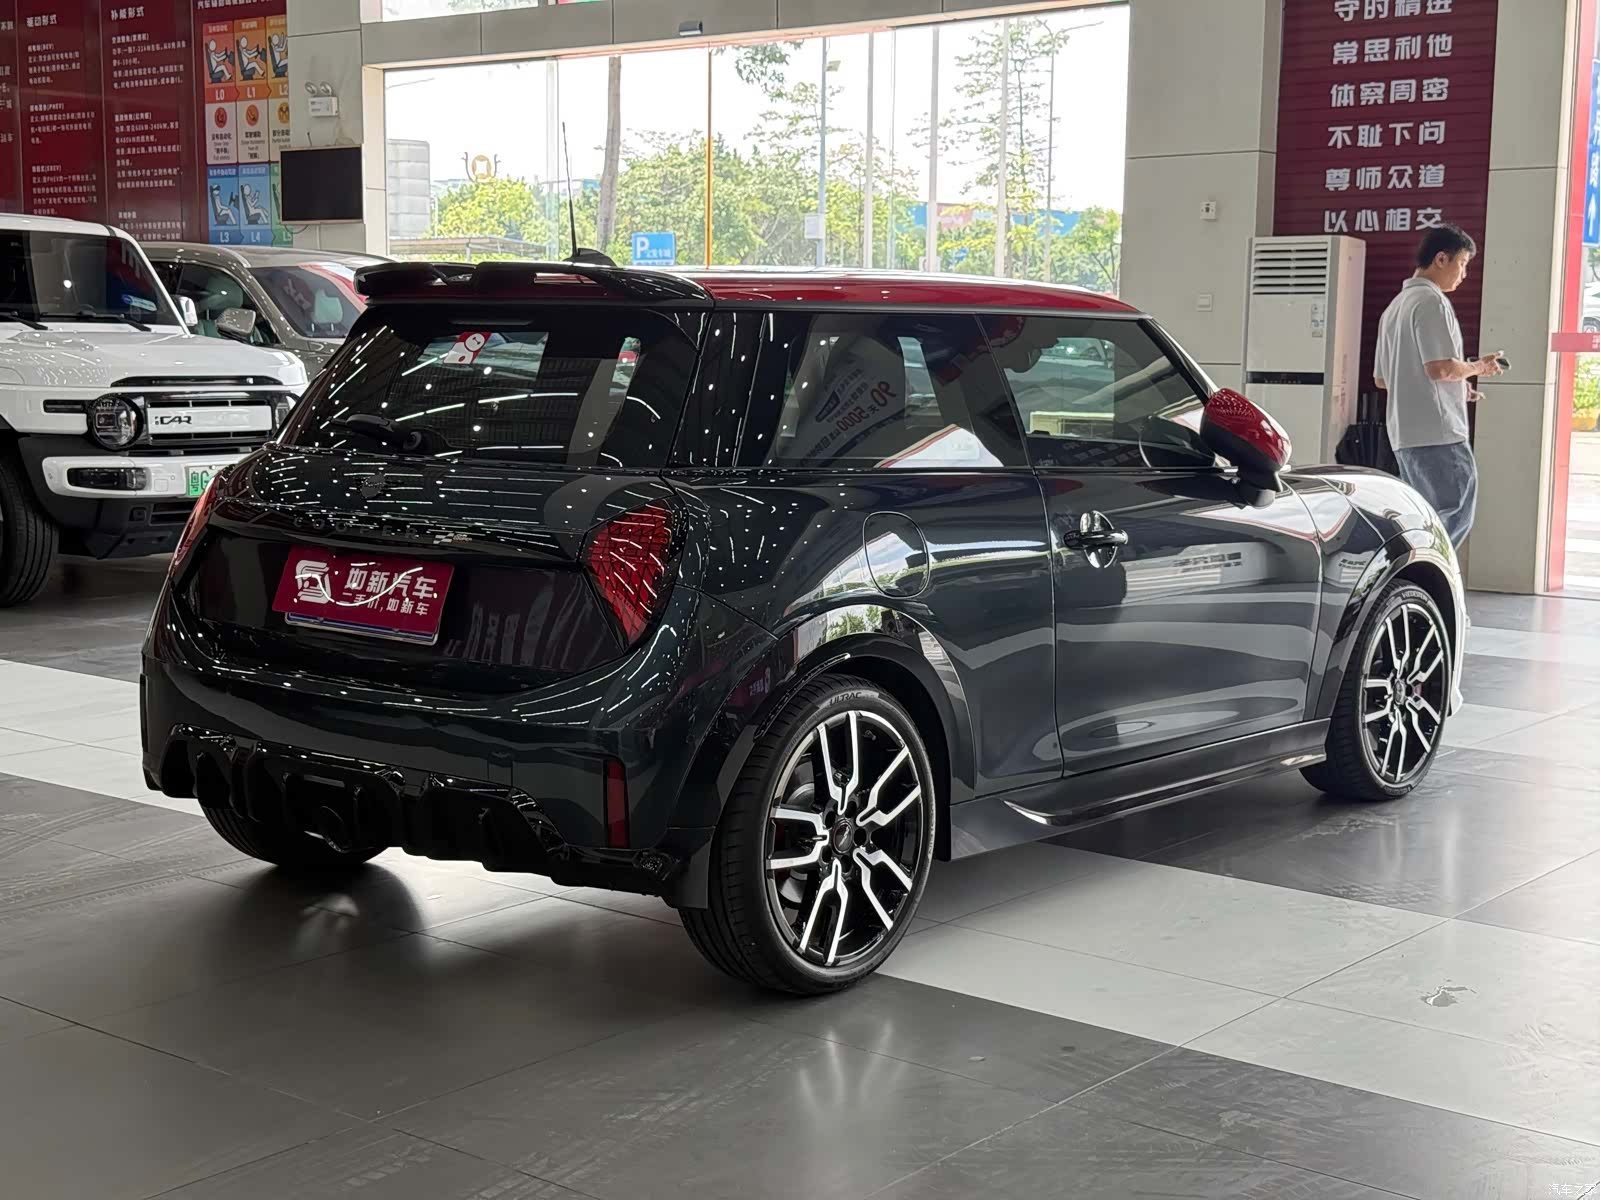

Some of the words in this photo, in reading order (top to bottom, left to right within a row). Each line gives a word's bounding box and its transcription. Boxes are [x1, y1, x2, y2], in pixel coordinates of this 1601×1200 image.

[26, 14, 57, 27] 驱动形式
[110, 6, 145, 20] 补能形式
[1334, 0, 1452, 21] 守时精进
[1333, 34, 1453, 64] 常思利他
[215, 88, 225, 101] L0
[246, 87, 256, 98] L1
[1330, 77, 1449, 107] 体察周密
[1327, 121, 1446, 149] 不耻下问
[1325, 164, 1445, 191] 尊师众道
[1323, 207, 1442, 233] 以心相交
[220, 231, 229, 242] L3
[251, 231, 260, 242] L4
[636, 236, 650, 259] P
[343, 567, 437, 600] 如新汽车
